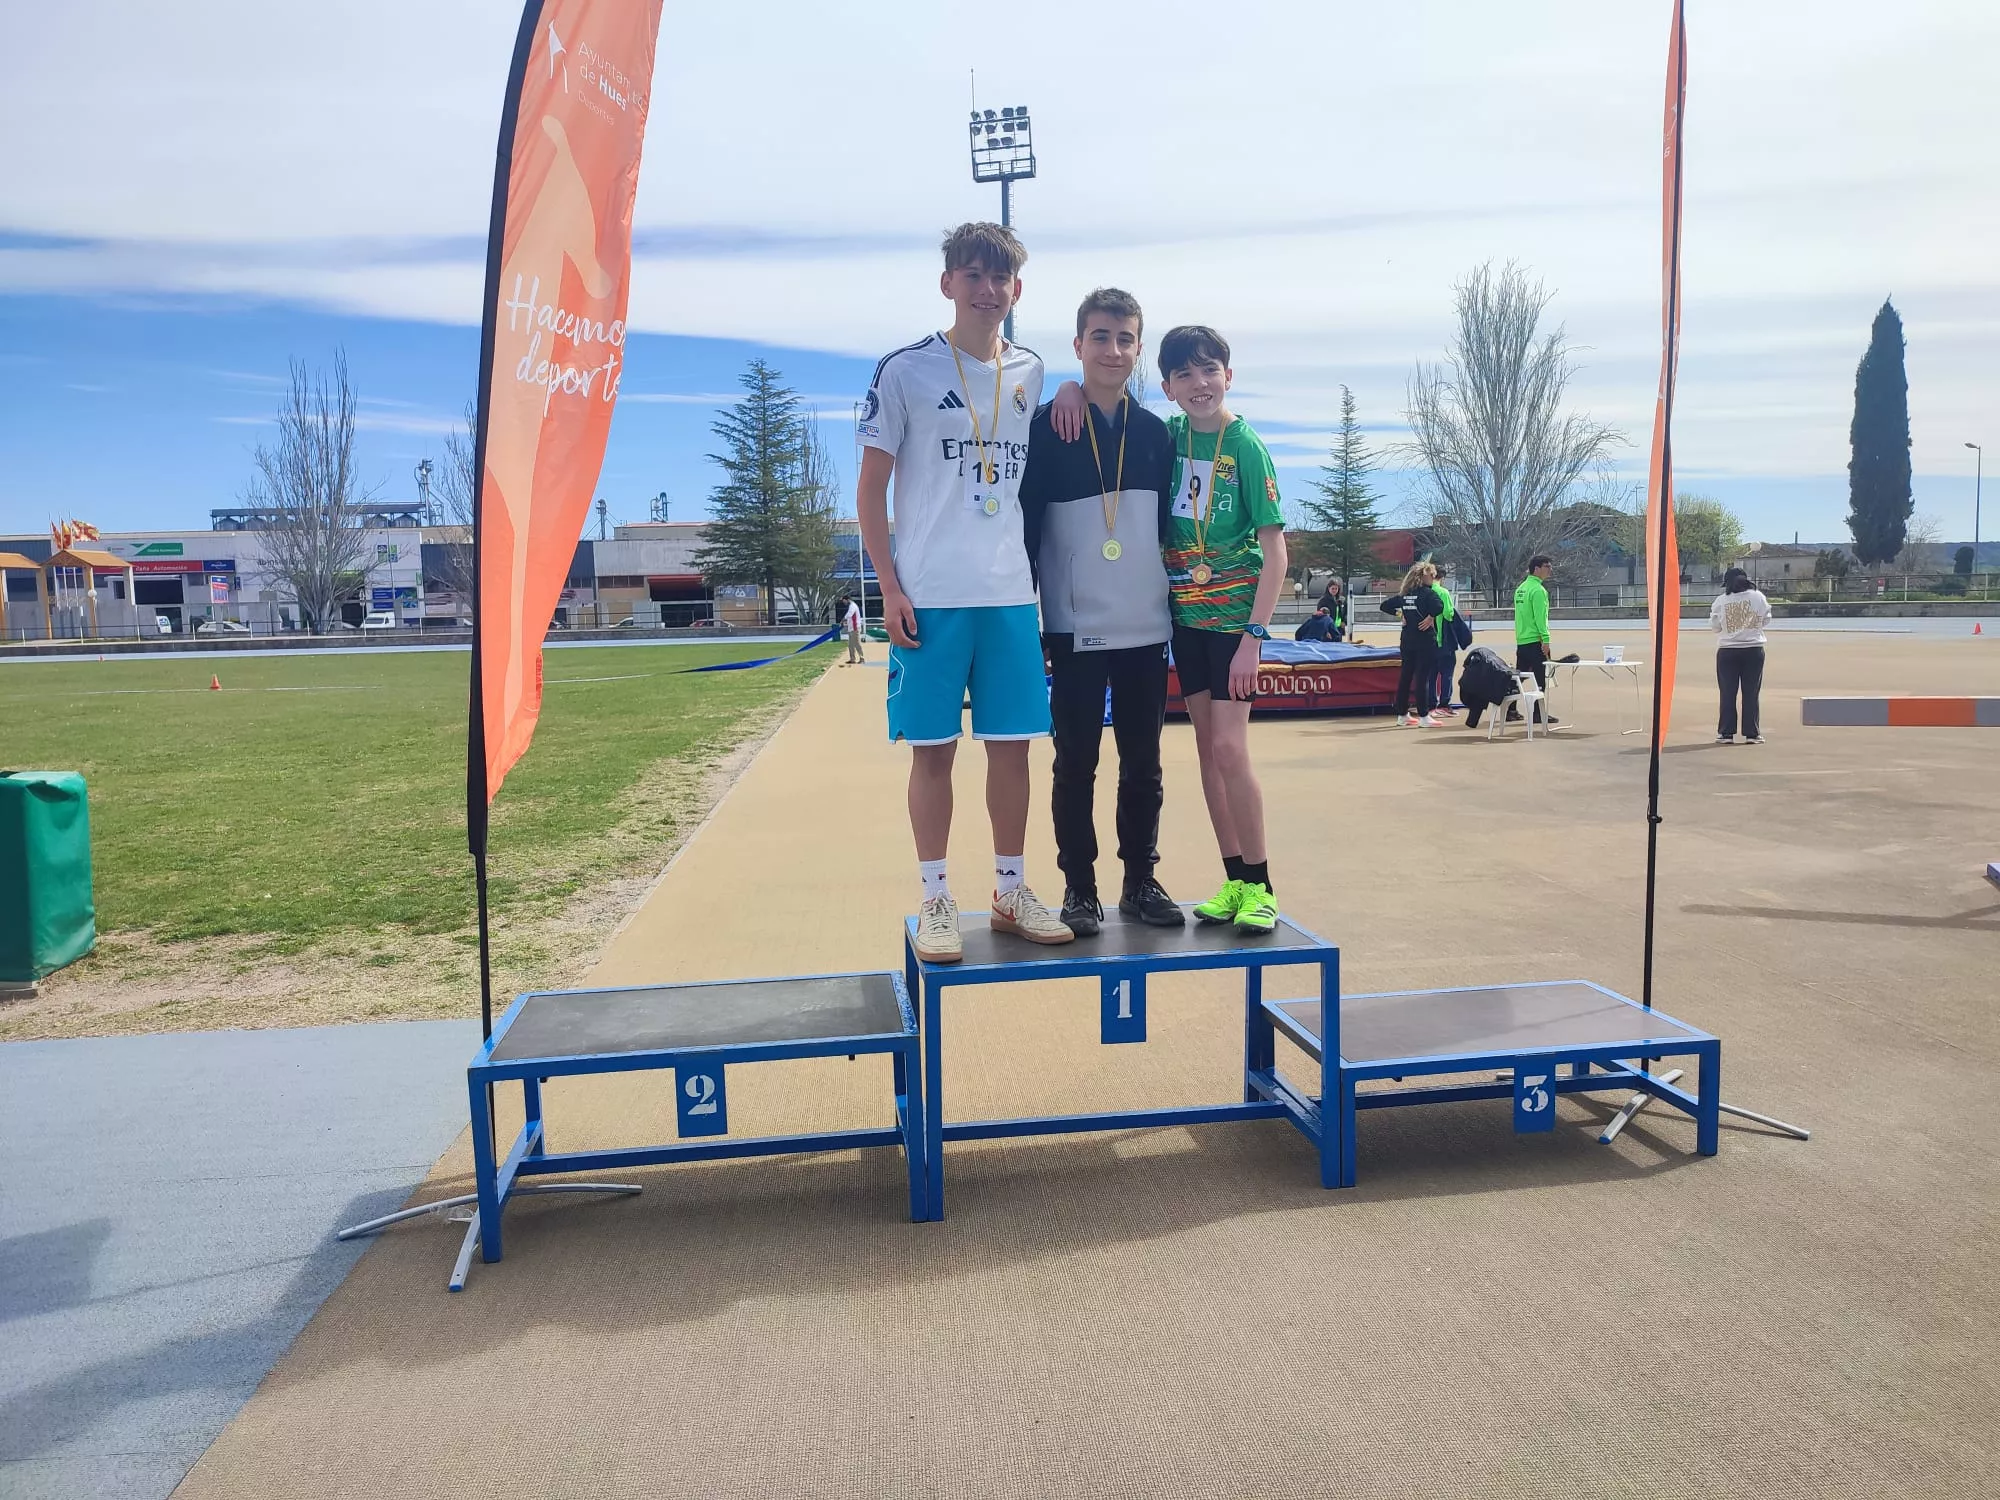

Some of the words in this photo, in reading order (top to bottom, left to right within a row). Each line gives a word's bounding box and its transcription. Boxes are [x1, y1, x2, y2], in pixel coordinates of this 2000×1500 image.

[580, 63, 596, 85] de
[599, 74, 628, 111] Hues
[972, 461, 1000, 485] 15
[1187, 475, 1202, 501] 9
[1256, 674, 1332, 696] ONDO
[1112, 979, 1133, 1019] 1
[685, 1075, 717, 1116] 2
[1521, 1075, 1549, 1112] 3
